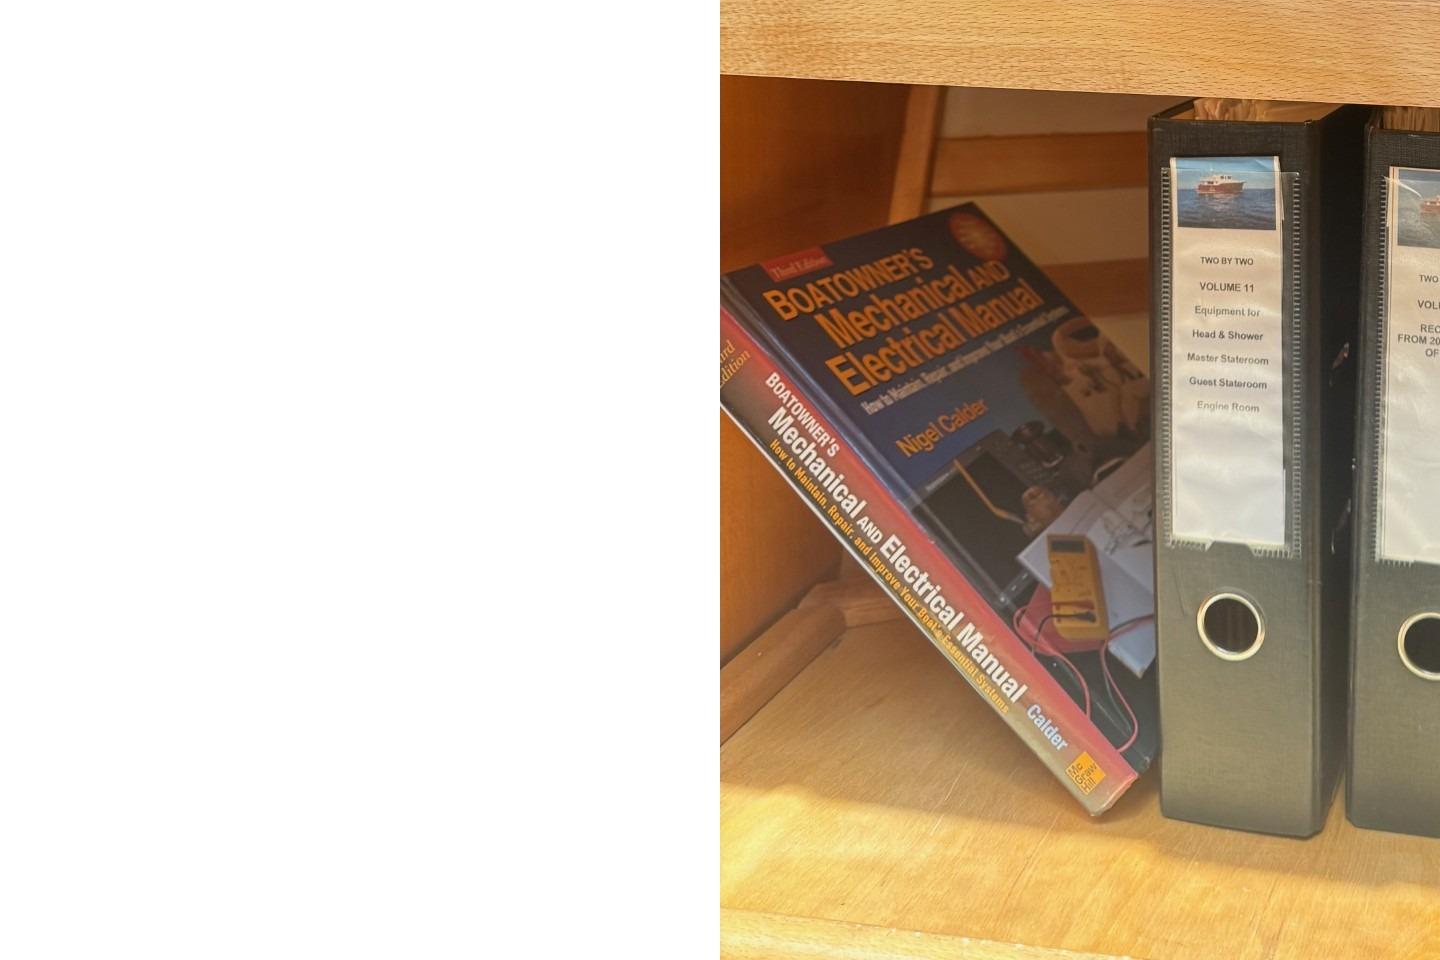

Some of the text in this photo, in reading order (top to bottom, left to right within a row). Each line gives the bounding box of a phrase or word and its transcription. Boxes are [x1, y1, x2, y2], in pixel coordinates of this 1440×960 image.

[1200, 256, 1254, 266] TWO BY TWO
[763, 248, 934, 321] BOATOWNER'S
[1419, 274, 1439, 284] TWO
[1199, 281, 1254, 293] VOLUME 11
[814, 266, 976, 349] Mechanical
[967, 259, 1011, 289] AND
[1194, 305, 1261, 318] Equipment for
[825, 313, 967, 396] Electrical
[948, 277, 1045, 338] Manual
[1192, 329, 1264, 341] Head & Shower
[1397, 333, 1427, 345] FROM
[1187, 352, 1269, 366] Master Stateroom
[1425, 348, 1440, 358] OF
[1189, 376, 1268, 390] Guest Stateroom
[1197, 400, 1260, 413] Engine Room
[765, 371, 840, 457] BOATOWNER'S
[896, 399, 989, 458] Nigel Calder
[767, 406, 1068, 750] Mechanical AND Electrical Manual Calder
[770, 438, 788, 461] How
[786, 457, 796, 471] to
[854, 536, 873, 556] and
[869, 552, 902, 590] Improve
[900, 586, 921, 610] Your
[942, 635, 979, 677] Essential
[976, 674, 1009, 714] Systems
[1081, 777, 1096, 792] Hill
